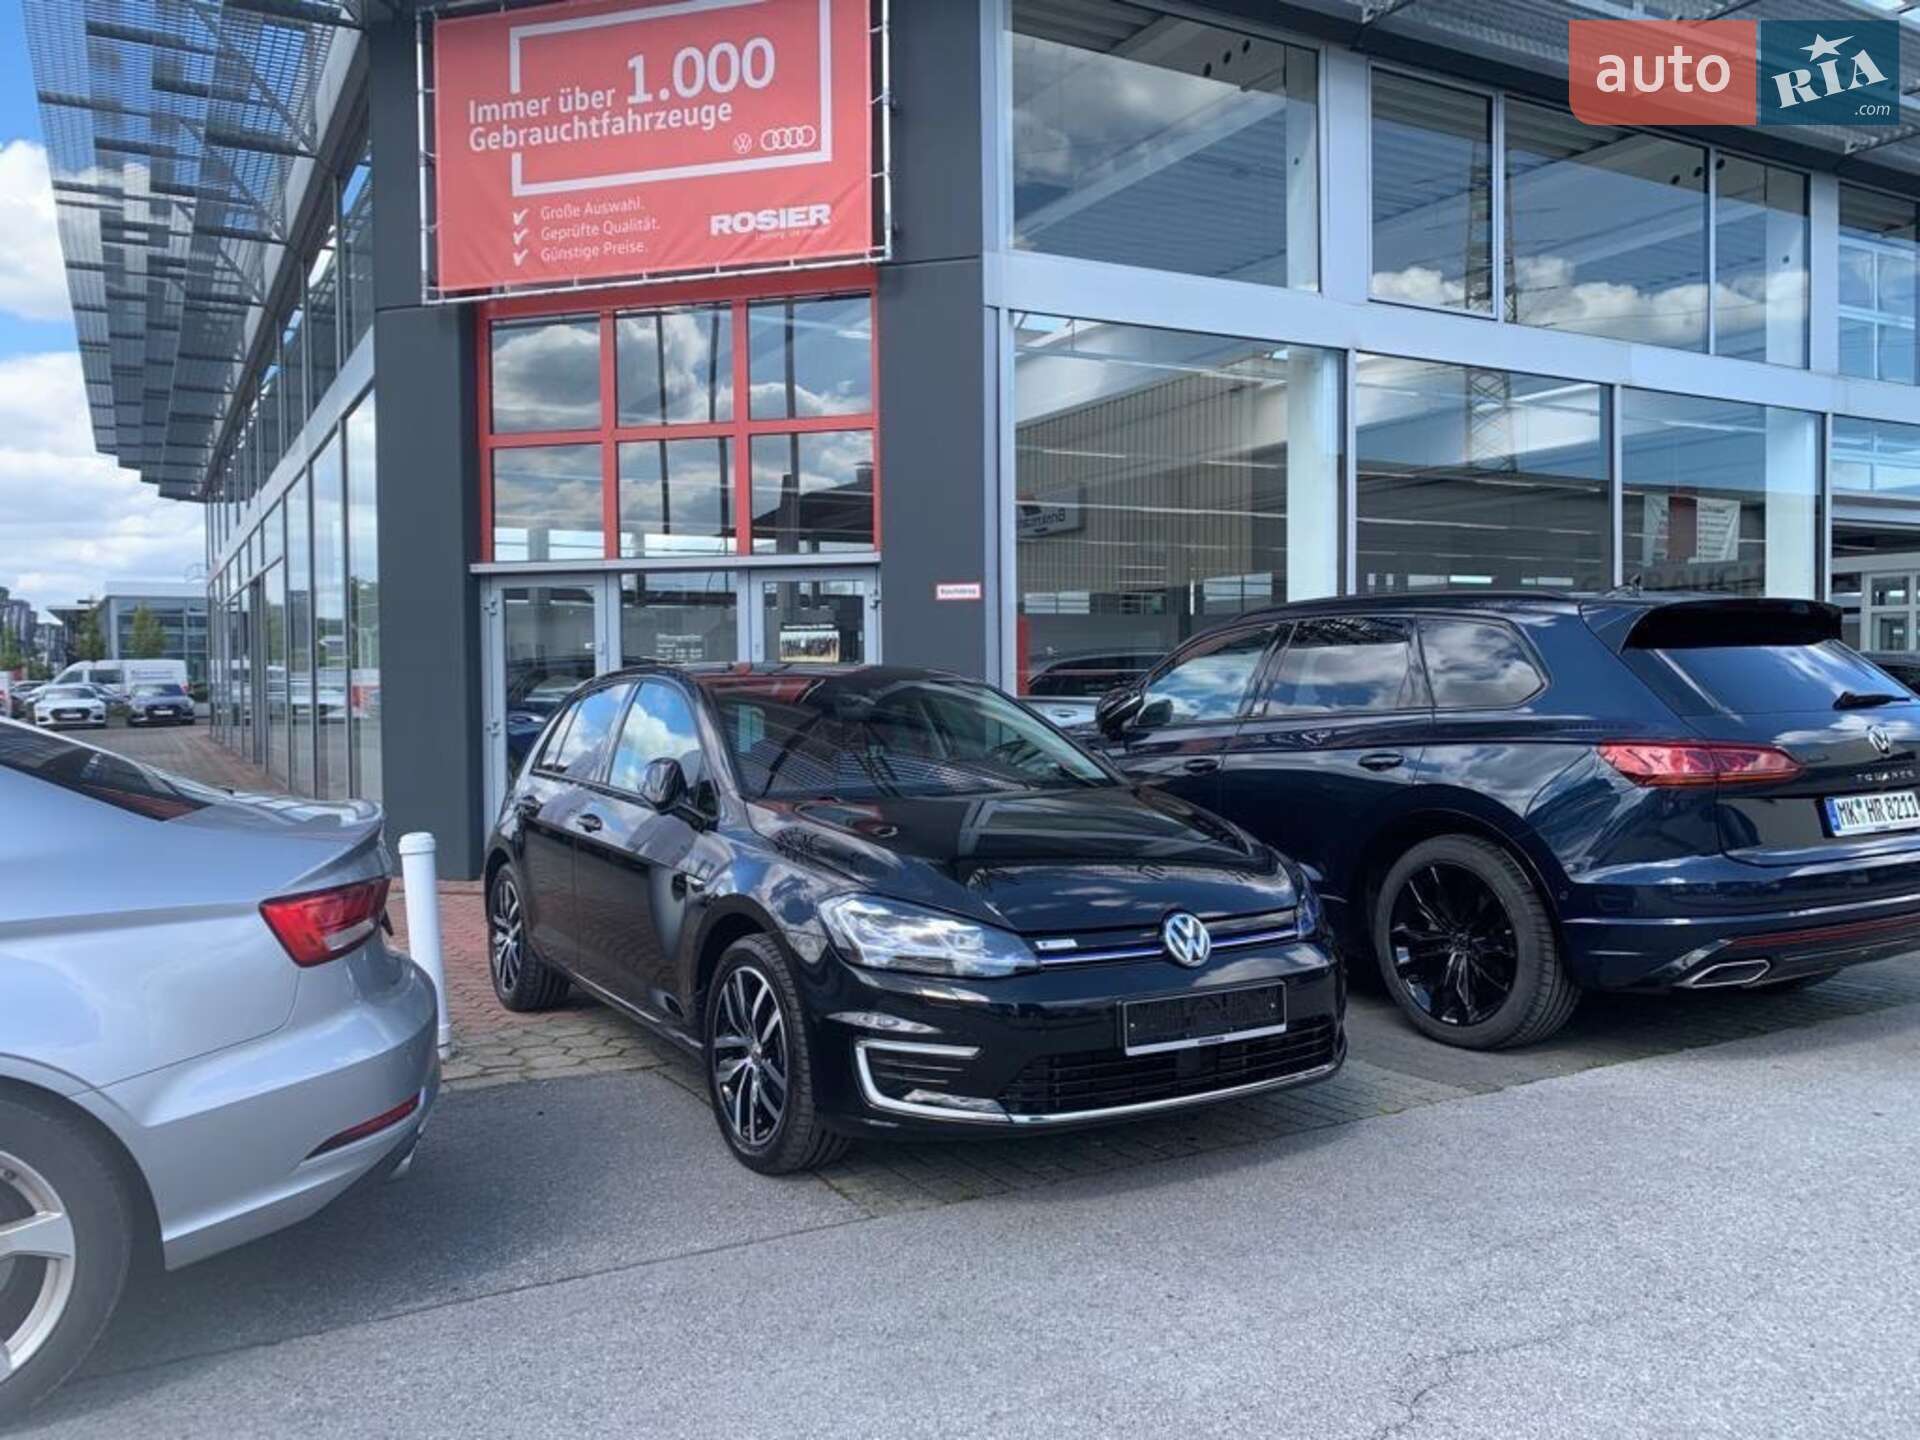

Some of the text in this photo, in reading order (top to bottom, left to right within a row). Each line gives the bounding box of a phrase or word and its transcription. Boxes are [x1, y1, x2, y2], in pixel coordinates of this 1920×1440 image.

[469, 37, 775, 124] Immer über 1.000
[469, 101, 732, 151] Gebrauchtfahrzeuge
[541, 196, 645, 220] Große Auswahl.
[710, 203, 832, 235] ROSIER
[541, 216, 661, 241] Geprüfte Qualität.
[541, 244, 599, 262] Günstige
[1884, 795, 1919, 820] 8211
